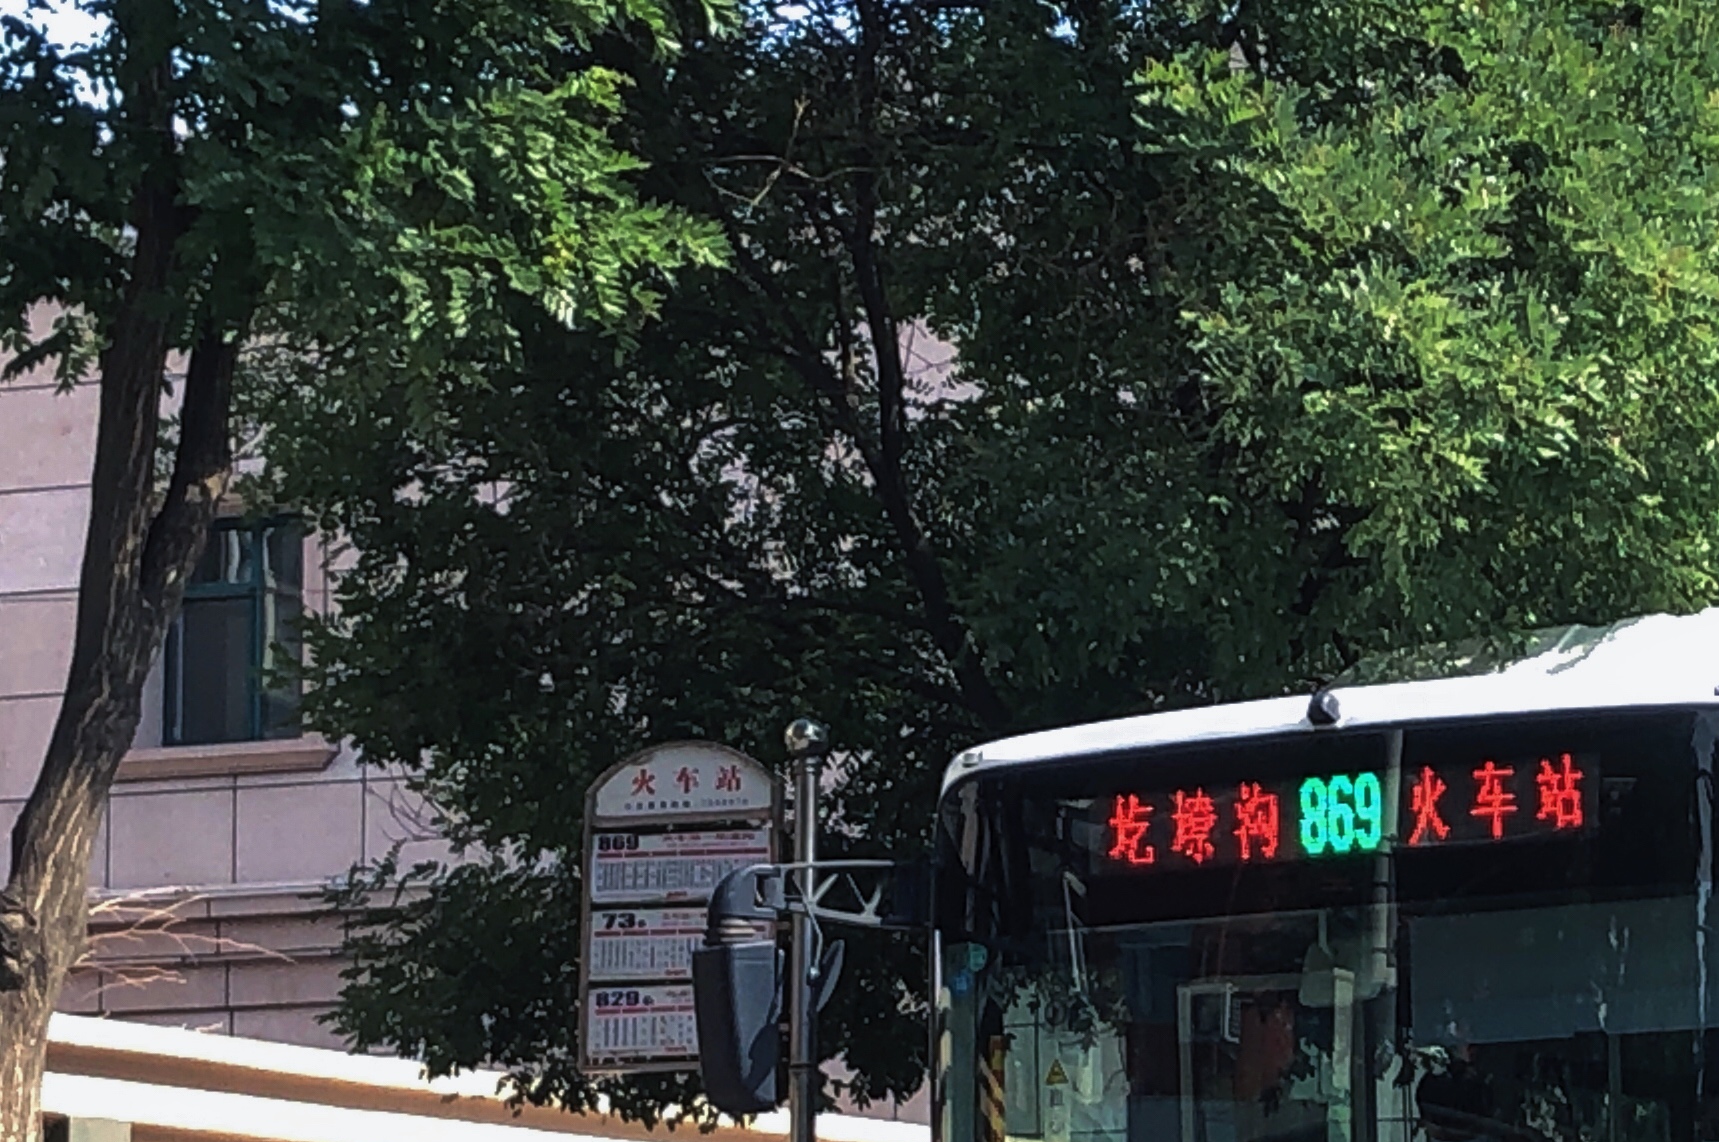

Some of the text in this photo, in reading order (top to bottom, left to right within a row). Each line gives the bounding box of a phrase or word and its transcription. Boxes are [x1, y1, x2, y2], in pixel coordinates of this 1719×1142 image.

[631, 764, 742, 796] 火车站
[1300, 771, 1382, 856] 869
[1408, 752, 1585, 847] 火车站
[598, 834, 640, 851] 869
